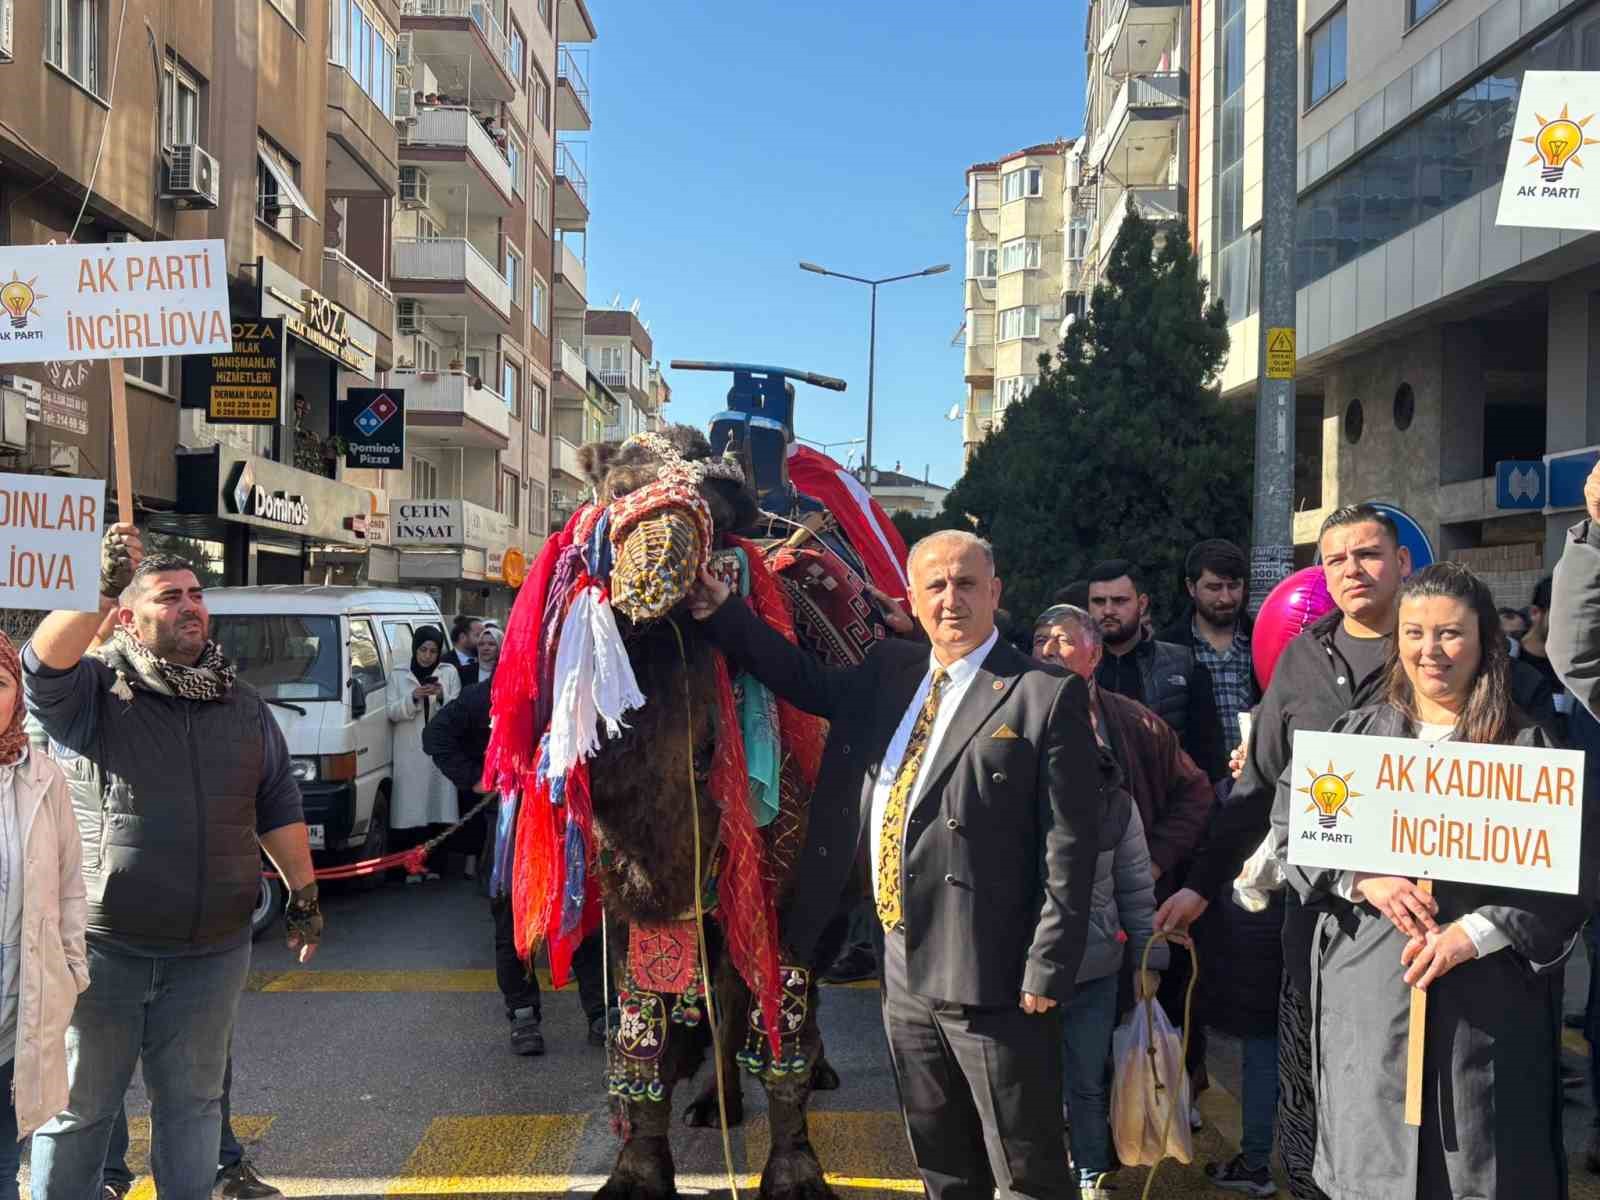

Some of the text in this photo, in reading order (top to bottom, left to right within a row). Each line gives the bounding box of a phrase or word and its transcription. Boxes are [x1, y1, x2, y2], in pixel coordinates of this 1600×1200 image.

[1517, 186, 1537, 197] AK
[78, 248, 211, 294] AK PARTİ
[66, 306, 228, 352] İNCİRLİOVA
[232, 323, 274, 339] OZA
[234, 342, 260, 353] MLAK
[349, 442, 401, 456] Domino's
[360, 454, 390, 464] Pizza
[255, 485, 309, 525] Domino's
[400, 503, 450, 521] ÇETİN
[397, 522, 456, 540] İNŞAAT
[1376, 754, 1575, 806] AK KADINLAR
[1301, 831, 1317, 841] AK
[1391, 809, 1552, 868] İNCİRLİOVA
